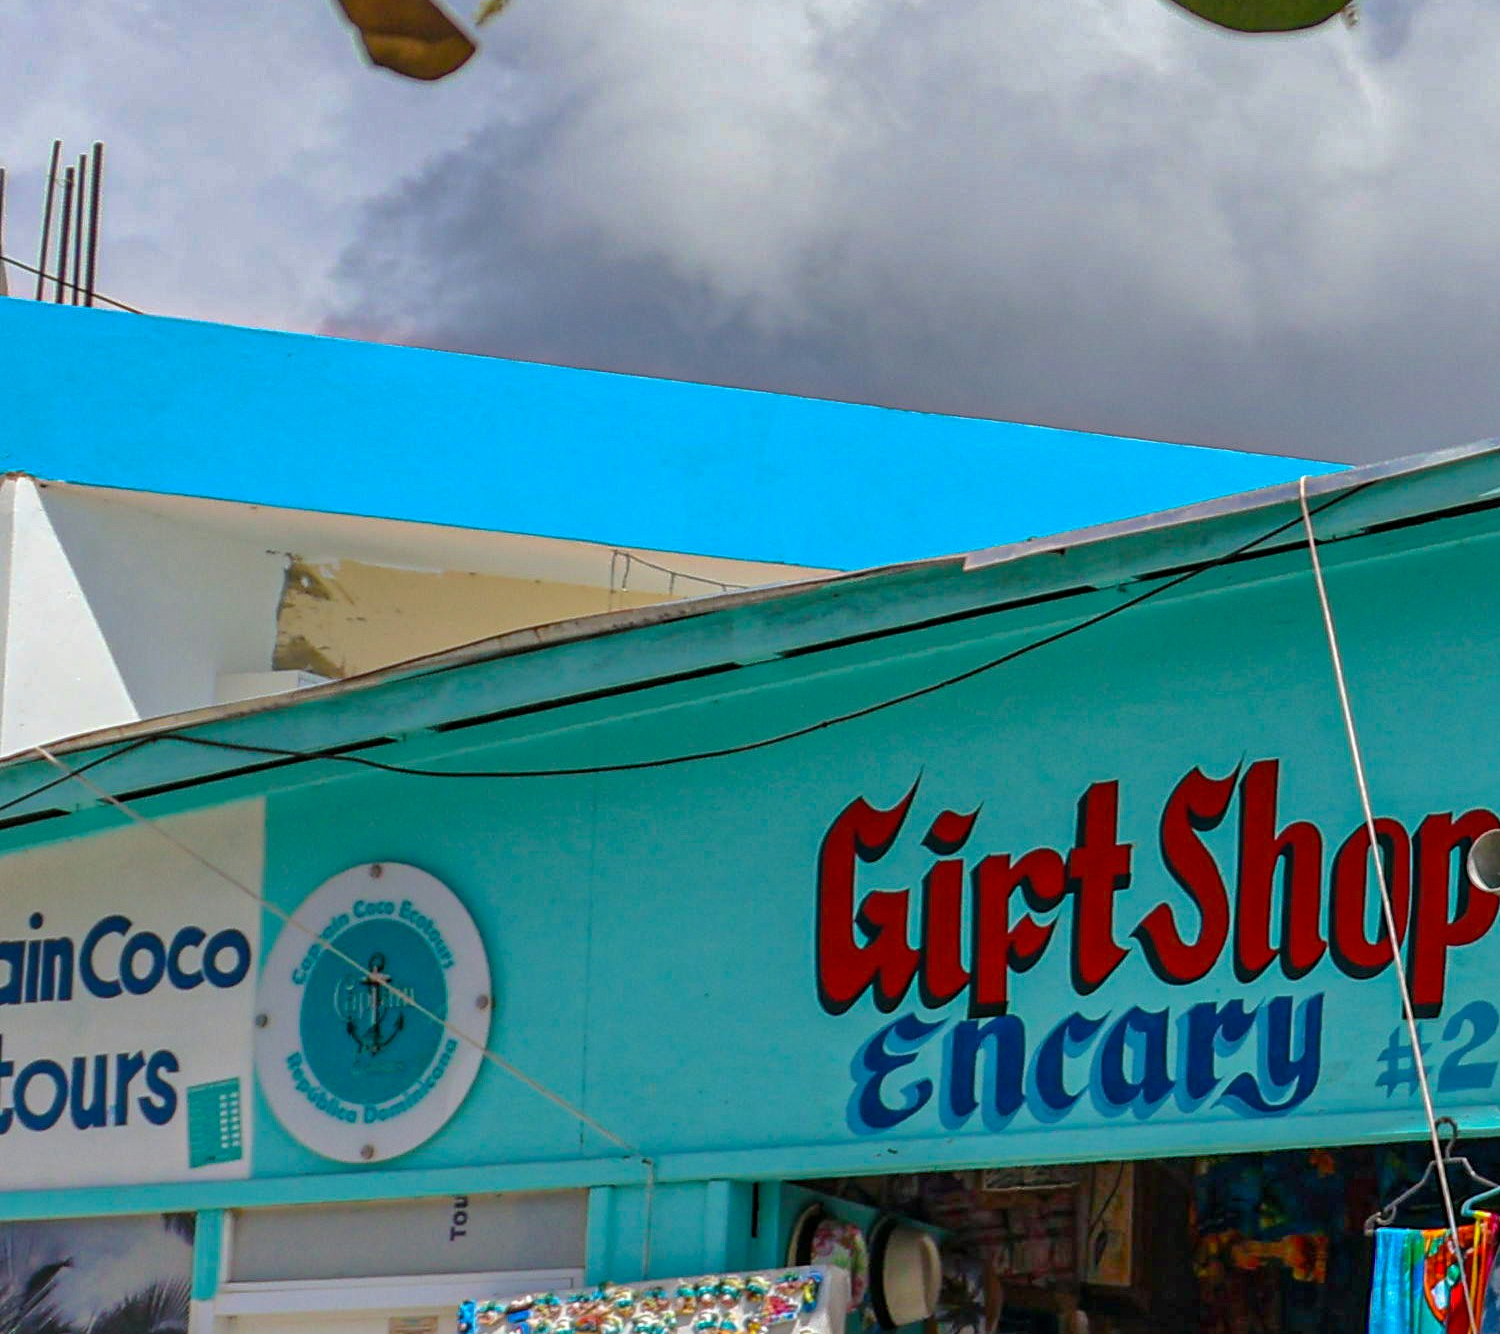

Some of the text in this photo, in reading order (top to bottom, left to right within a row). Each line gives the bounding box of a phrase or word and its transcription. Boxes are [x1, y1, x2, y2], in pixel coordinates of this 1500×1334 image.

[79, 914, 252, 999] Coco
[816, 765, 1135, 1019] Gift
[846, 992, 1500, 1135] Encary #2
